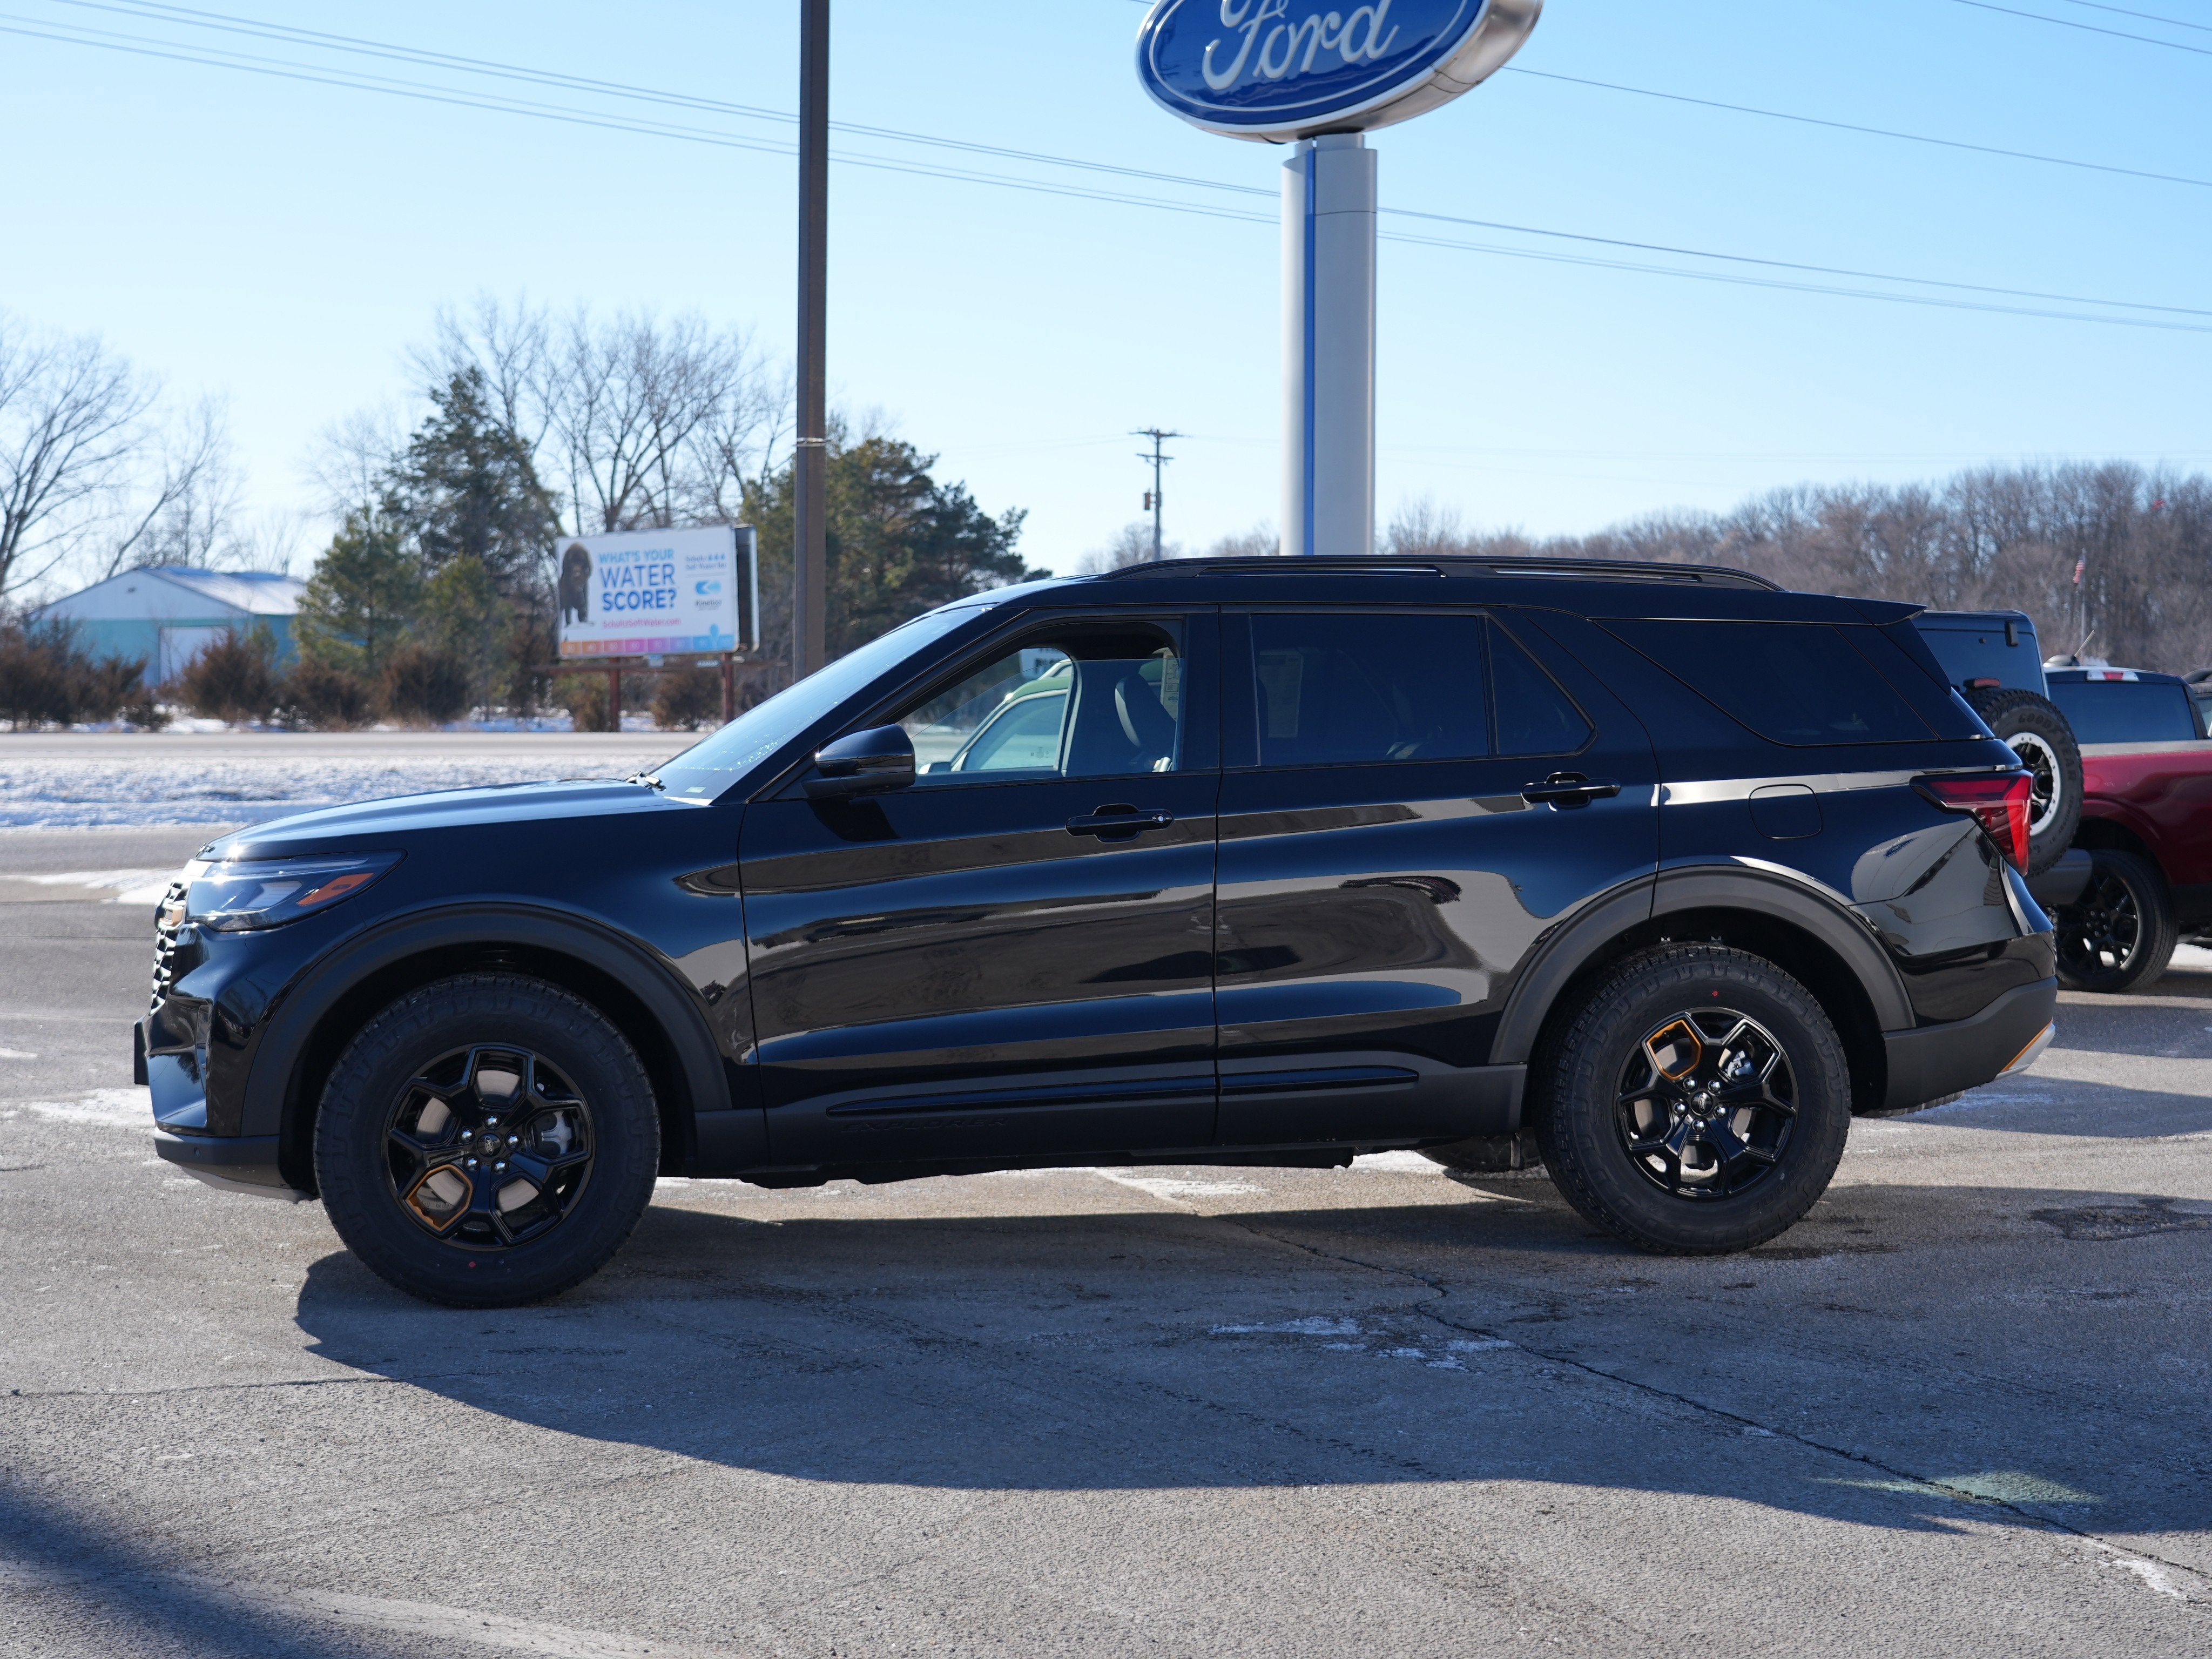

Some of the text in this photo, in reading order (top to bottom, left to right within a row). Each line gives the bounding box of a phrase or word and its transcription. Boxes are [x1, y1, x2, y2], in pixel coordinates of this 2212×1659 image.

[1202, 0, 1399, 90] Ford
[599, 548, 675, 563] WHAT'S YOUR
[599, 563, 675, 588] WATER
[602, 589, 677, 611] SCORE?
[841, 1117, 1008, 1133] EXPLORER
